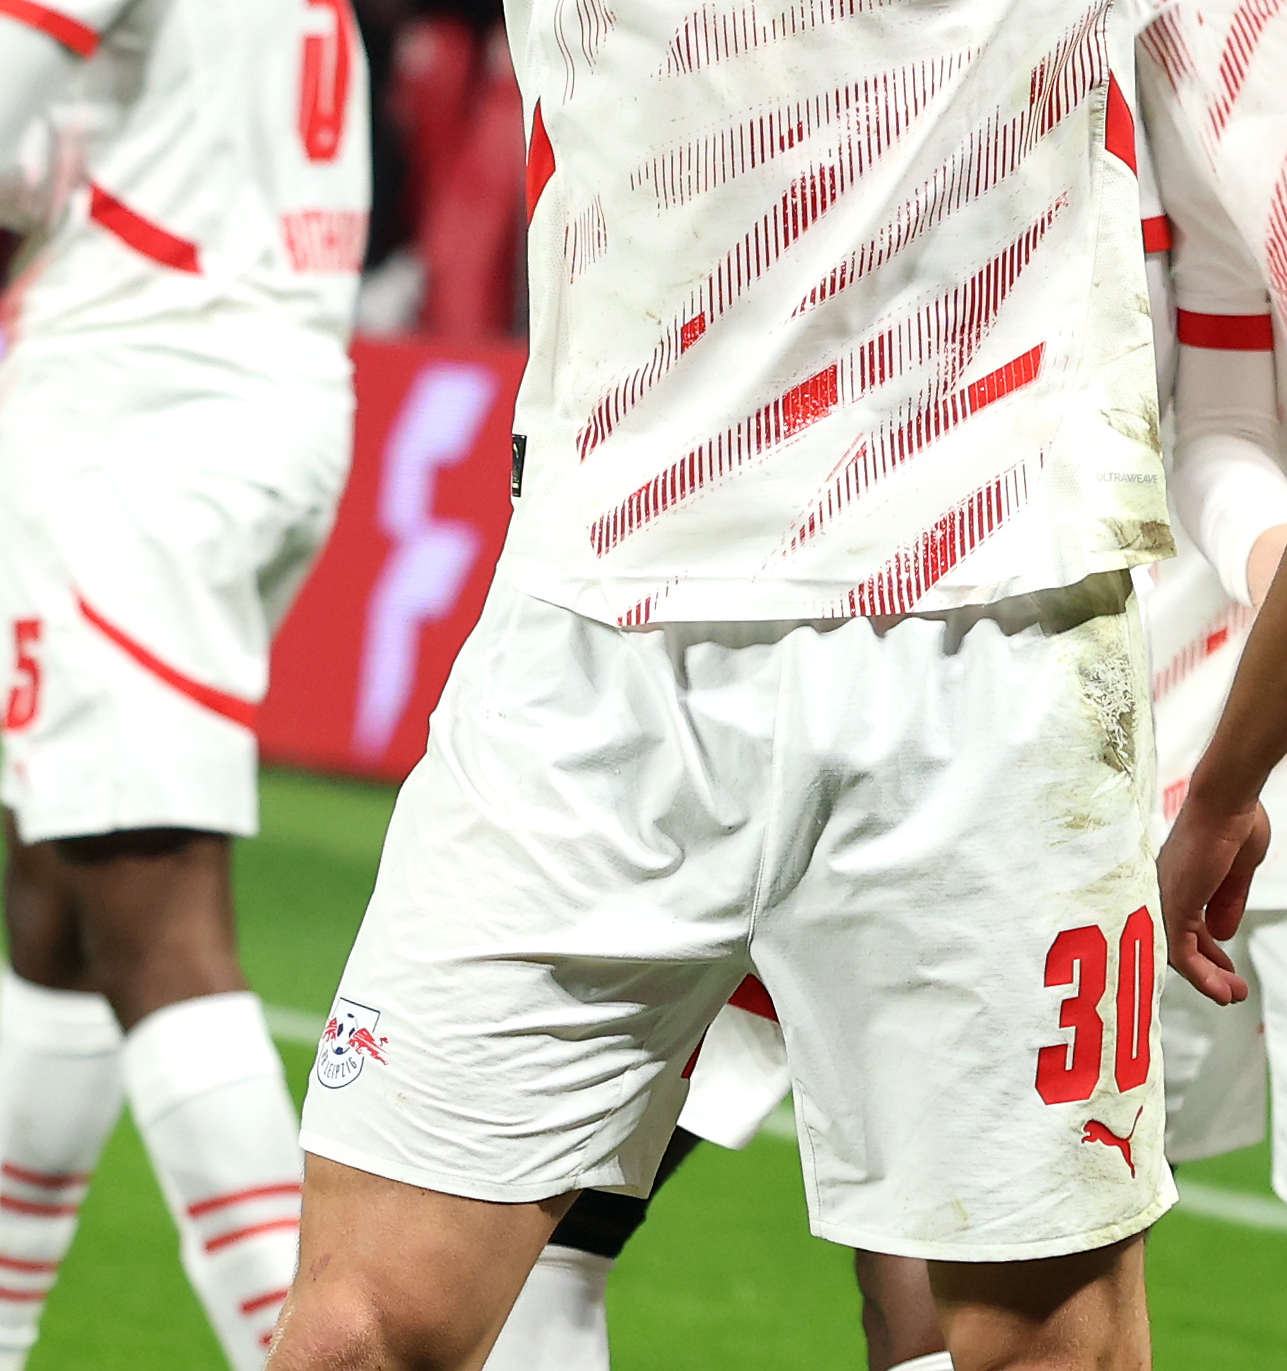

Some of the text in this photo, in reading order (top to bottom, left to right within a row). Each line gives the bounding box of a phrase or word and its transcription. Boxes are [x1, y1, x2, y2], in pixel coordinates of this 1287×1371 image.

[1096, 472, 1158, 484] ULTRAWEAVE
[8, 619, 39, 729] 5
[1034, 905, 1154, 1105] 30
